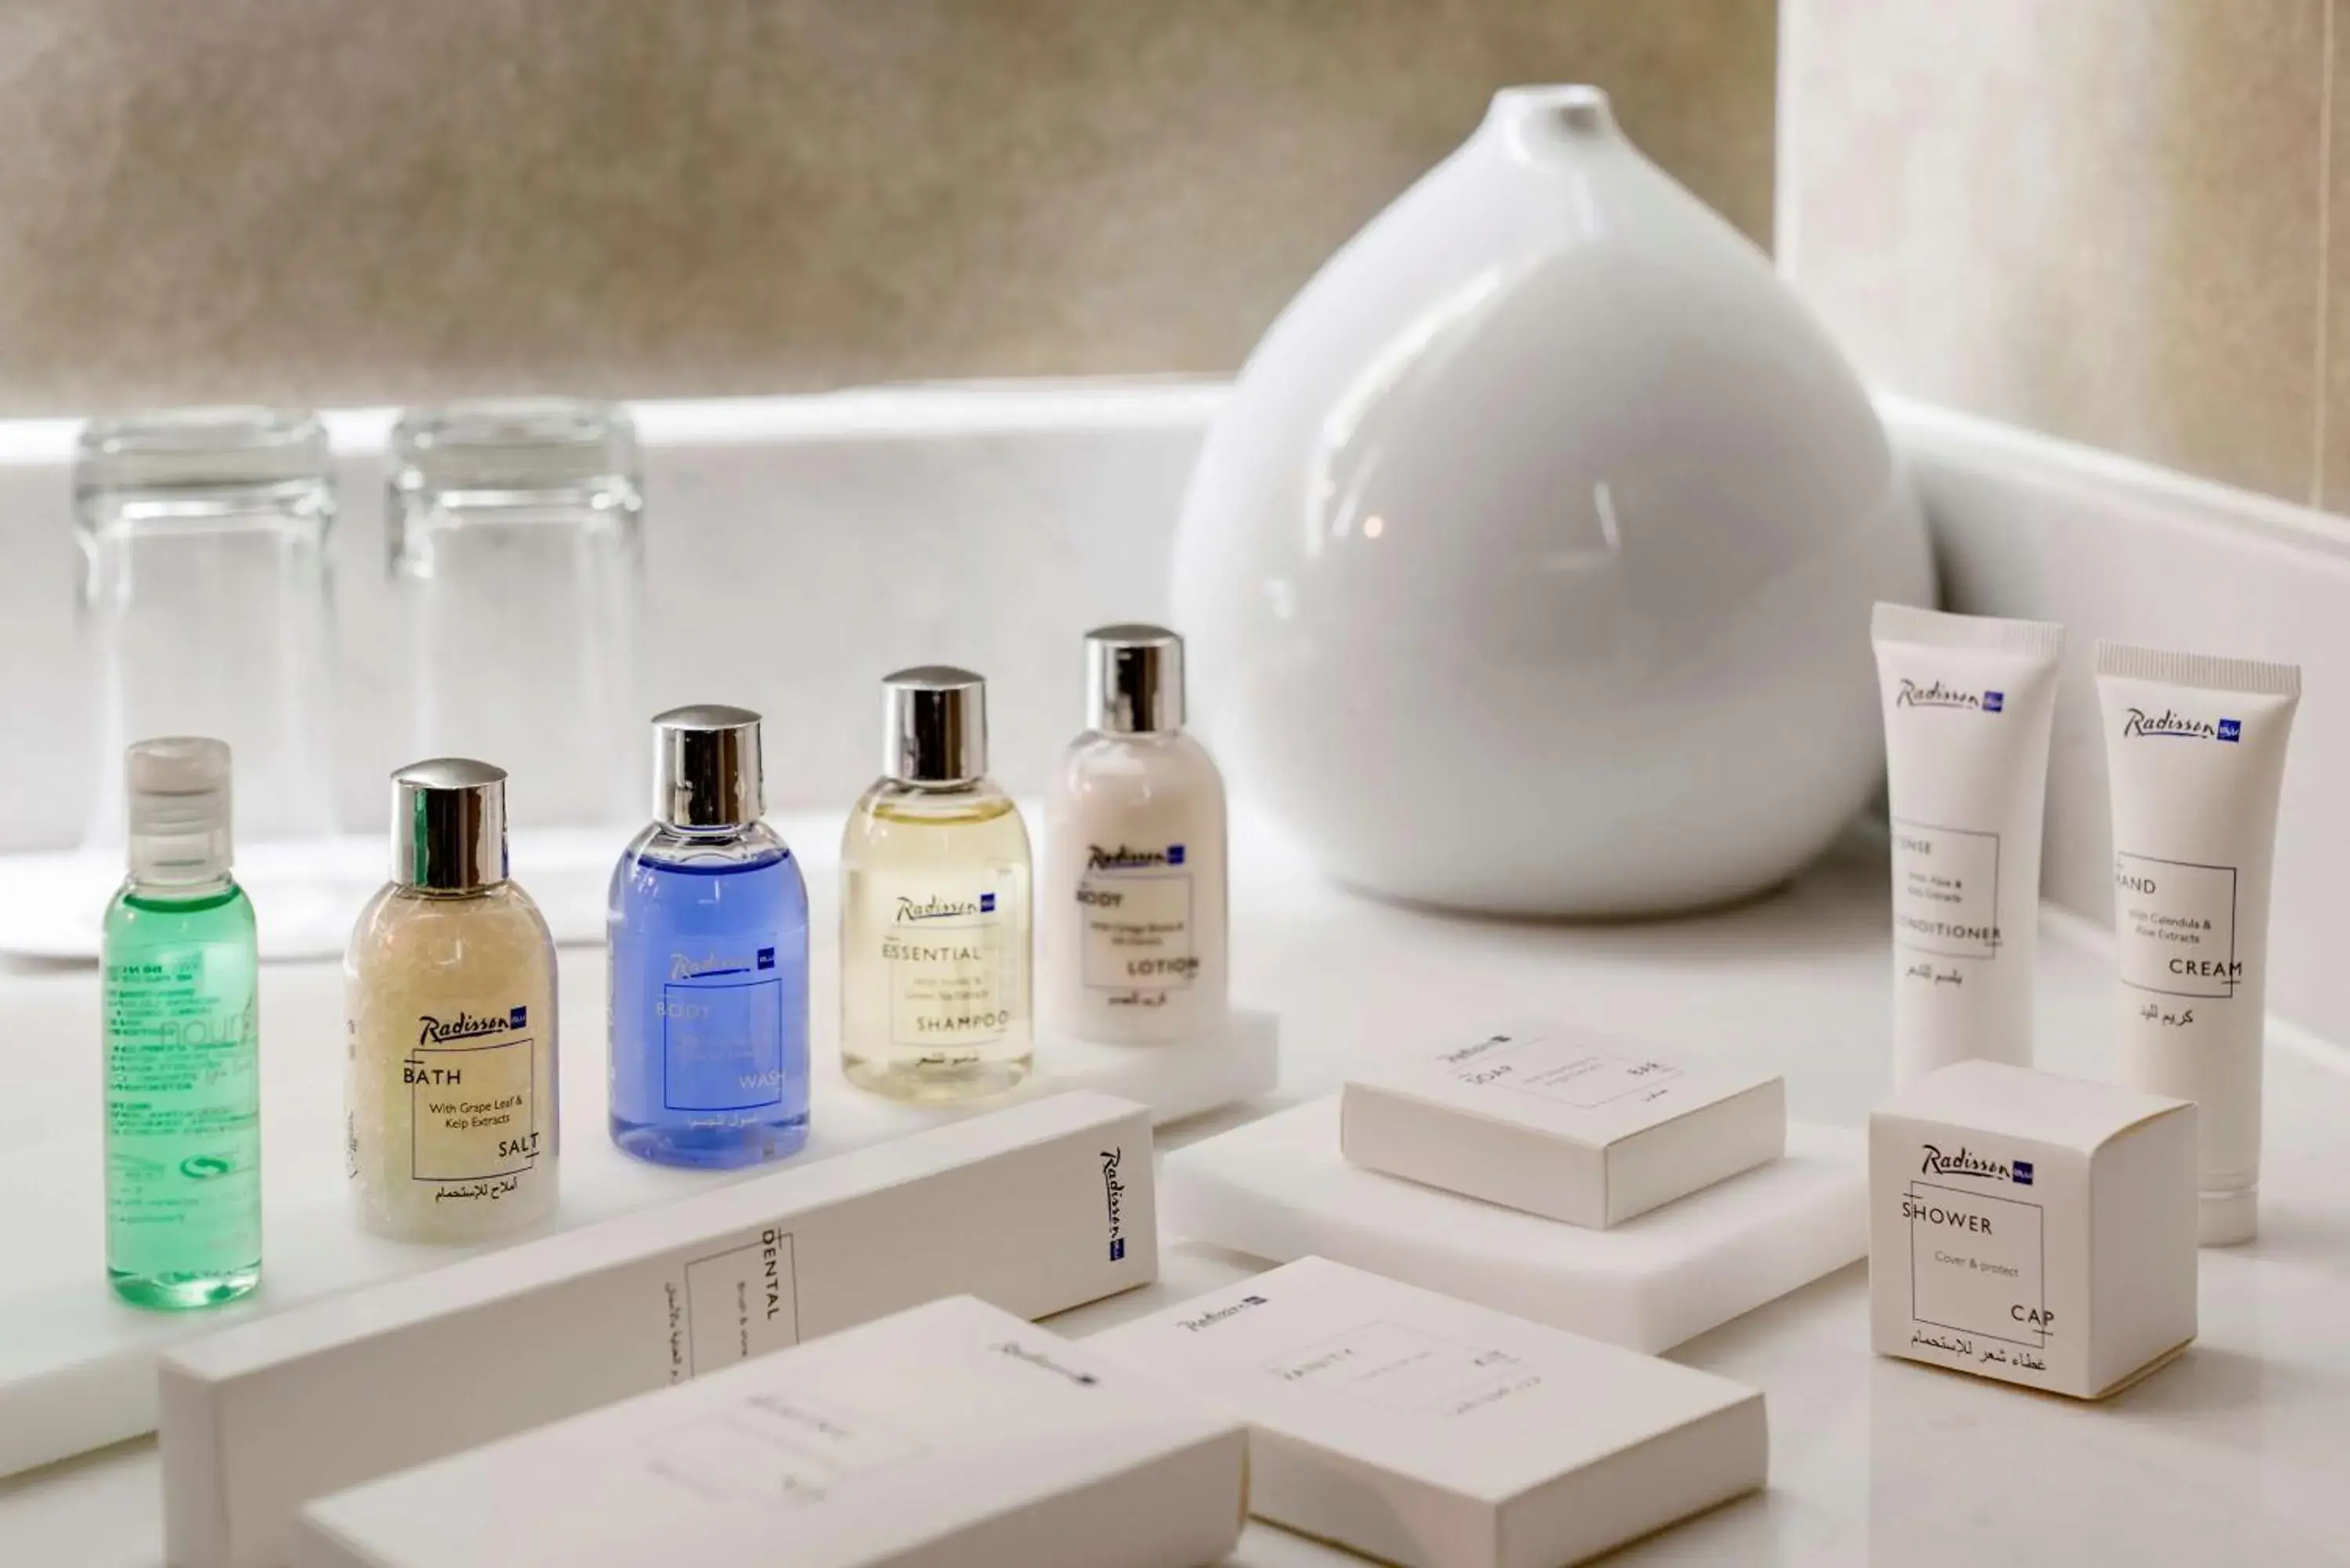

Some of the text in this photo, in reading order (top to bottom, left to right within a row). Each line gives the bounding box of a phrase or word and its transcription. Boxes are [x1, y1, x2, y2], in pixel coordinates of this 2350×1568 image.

[1896, 678, 1979, 709] Radisson
[2124, 708, 2214, 738] Radisson
[896, 894, 978, 921] Radisson
[883, 944, 982, 962] ESSENTIAL
[2169, 959, 2243, 977] CREAM
[418, 1011, 509, 1046] Radisson
[916, 1010, 1010, 1032] SHAMPOO
[403, 1068, 461, 1086] BATH
[429, 1094, 524, 1116] With Grape Leaf &
[446, 1113, 512, 1131] Kelp Extracts
[498, 1132, 540, 1158] SALT
[1922, 1144, 2012, 1180] Radisson
[1100, 1147, 1126, 1239] Radisson
[1902, 1201, 1993, 1235] SHOWER
[761, 1229, 780, 1321] DENTAL
[1934, 1250, 2019, 1277] Cover & protect
[2010, 1304, 2055, 1328] CAP
